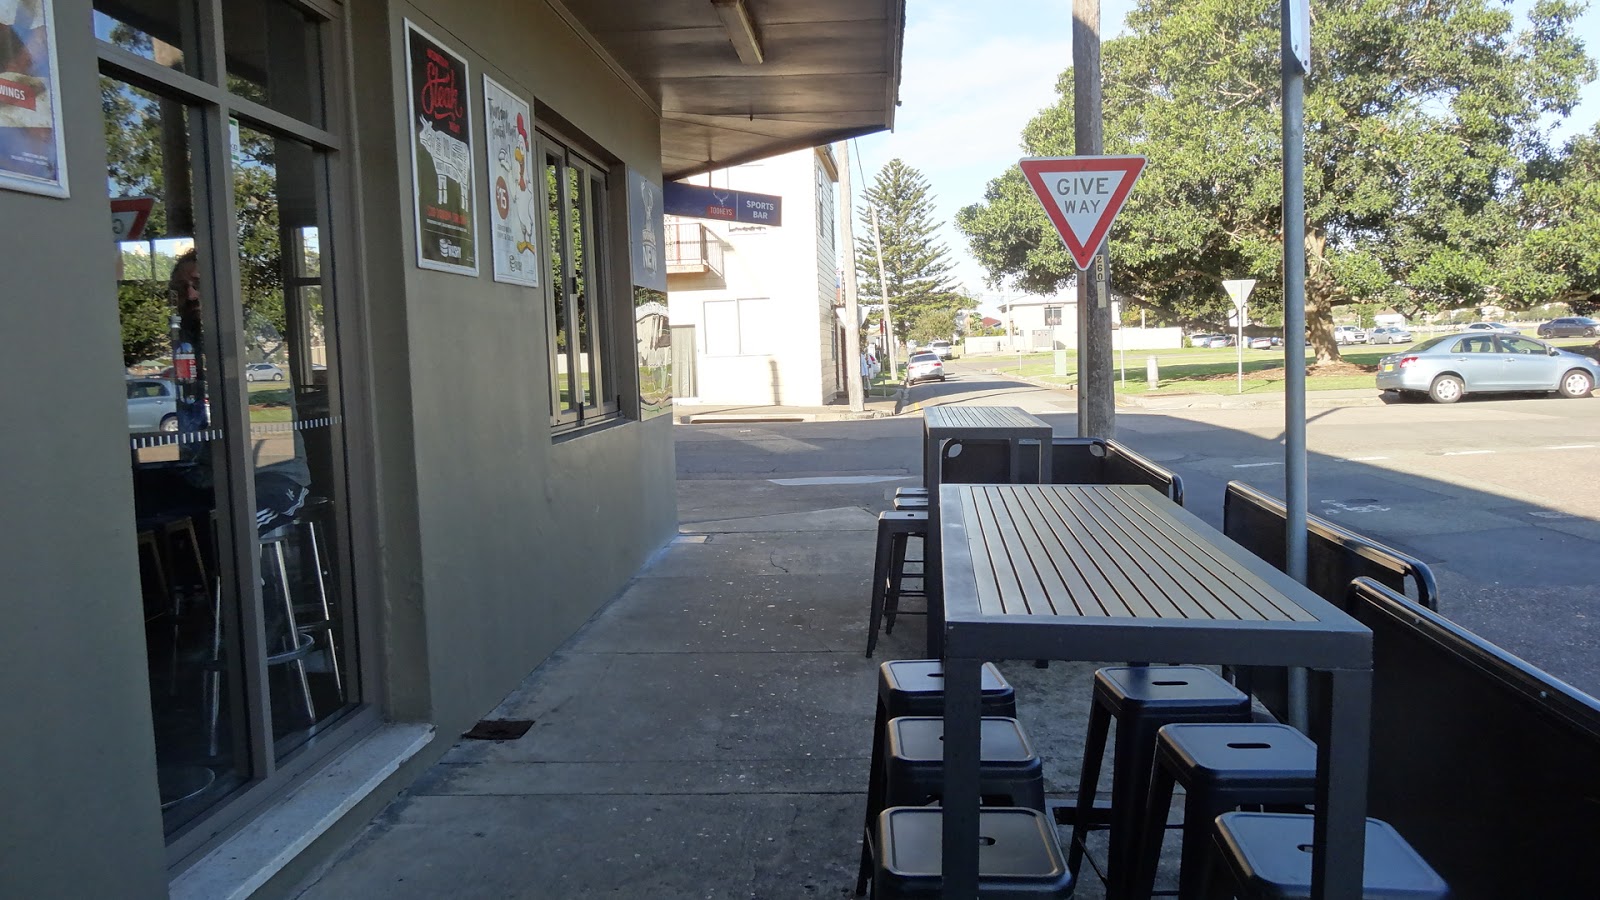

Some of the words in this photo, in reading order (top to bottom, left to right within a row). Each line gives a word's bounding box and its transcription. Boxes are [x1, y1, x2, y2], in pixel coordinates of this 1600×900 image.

[0, 84, 26, 101] WINGS
[421, 61, 464, 118] Steak
[1056, 177, 1109, 196] GIVE
[746, 199, 775, 211] SPORTS
[1064, 199, 1101, 214] WAY
[752, 210, 769, 220] BAR
[1096, 255, 1104, 281] 260
